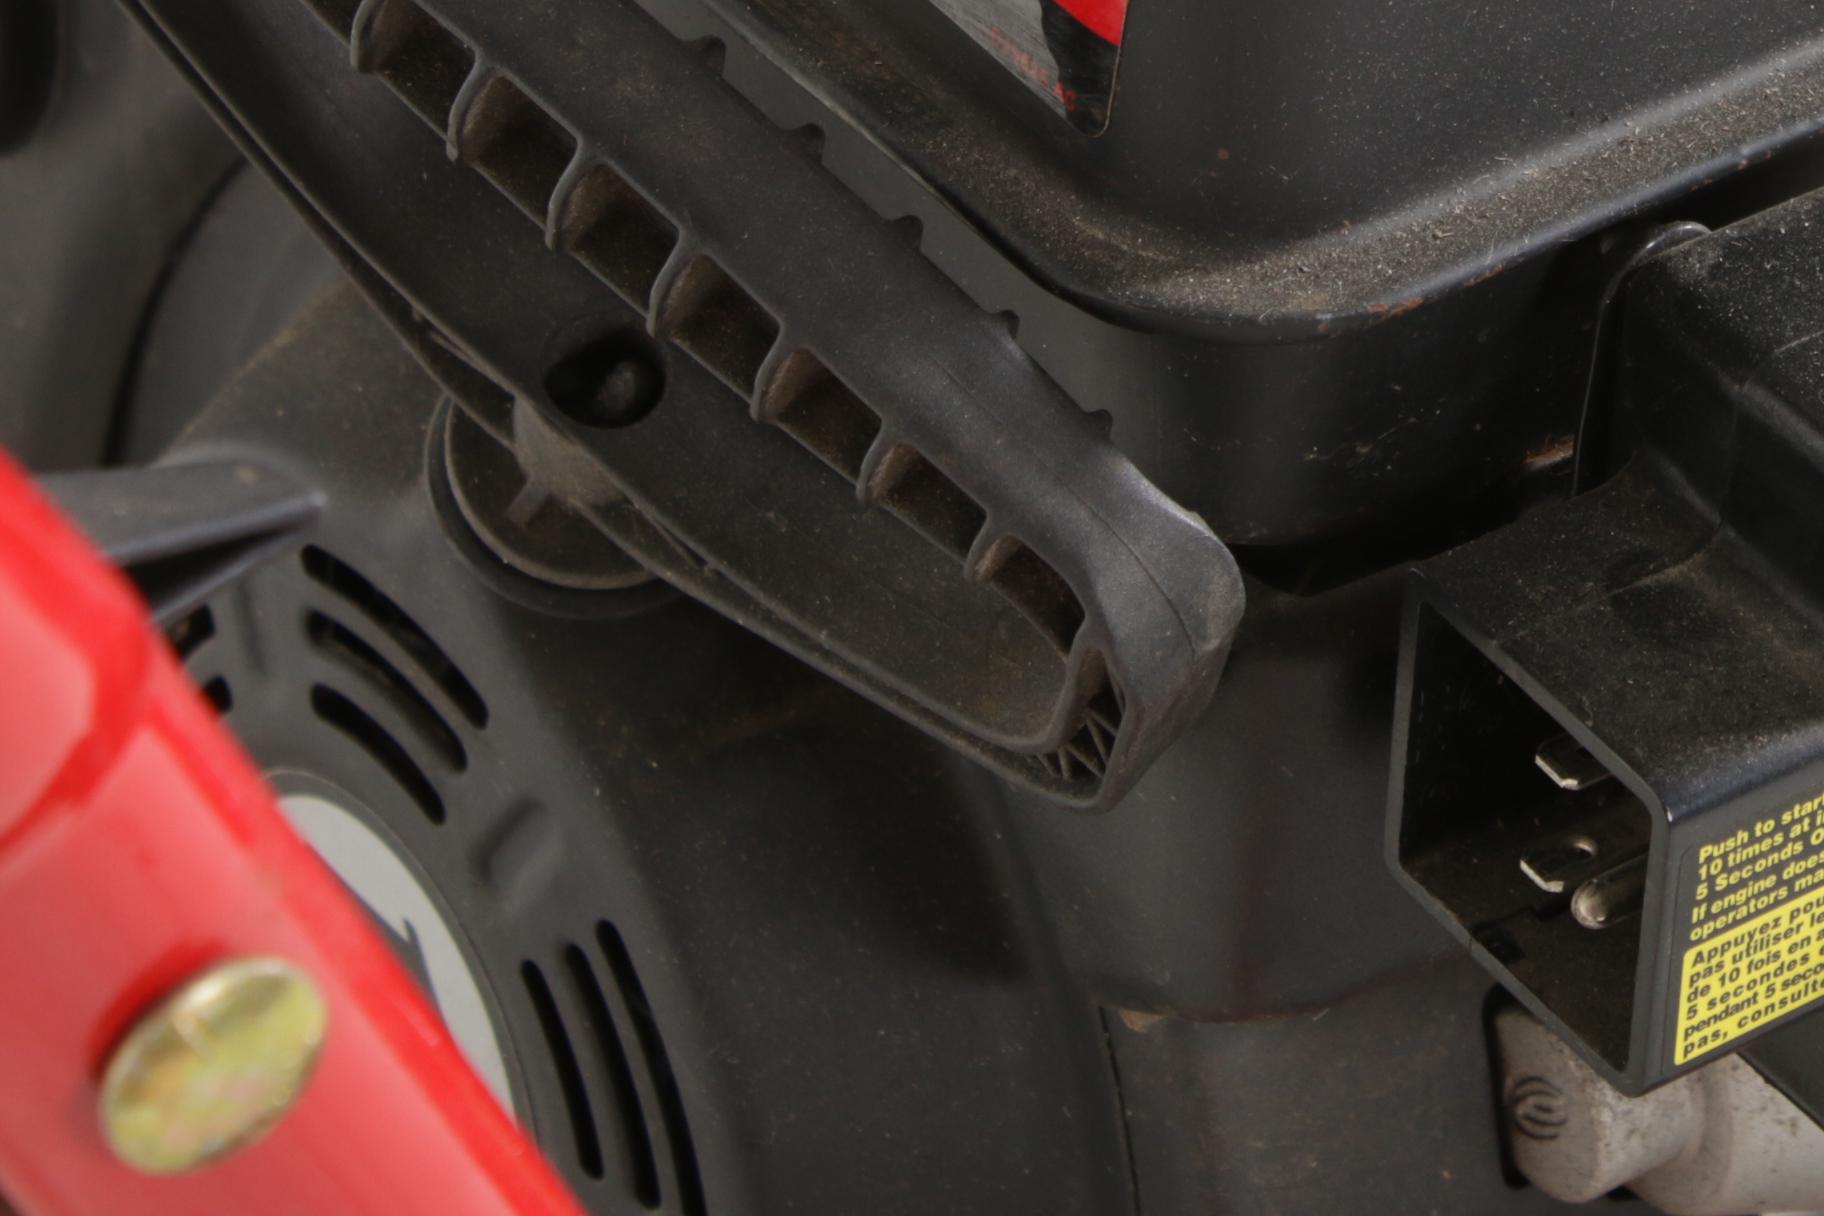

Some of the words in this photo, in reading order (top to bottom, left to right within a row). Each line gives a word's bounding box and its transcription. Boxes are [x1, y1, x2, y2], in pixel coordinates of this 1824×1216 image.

[1695, 880, 1708, 902] 5
[1714, 835, 1804, 892] Seconds
[1697, 855, 1723, 883] 10
[1726, 827, 1784, 869] times
[1789, 814, 1812, 840] at
[1698, 825, 1750, 864] Push
[1753, 813, 1776, 839] to
[1689, 883, 1788, 945] operators
[1690, 902, 1707, 925] If
[1710, 870, 1777, 919] engine
[1687, 980, 1711, 1005] de
[1717, 966, 1740, 990] 10
[1746, 945, 1782, 976] fois
[1787, 933, 1811, 956] en
[1688, 958, 1725, 990] pas
[1731, 916, 1805, 965] utiliser
[1691, 912, 1781, 974] Appuyez
[1683, 990, 1759, 1044] pendant
[1764, 982, 1776, 1000] 5
[1686, 1003, 1698, 1022] 5
[1706, 948, 1810, 1012] secondes
[1682, 1023, 1728, 1061] pas,
